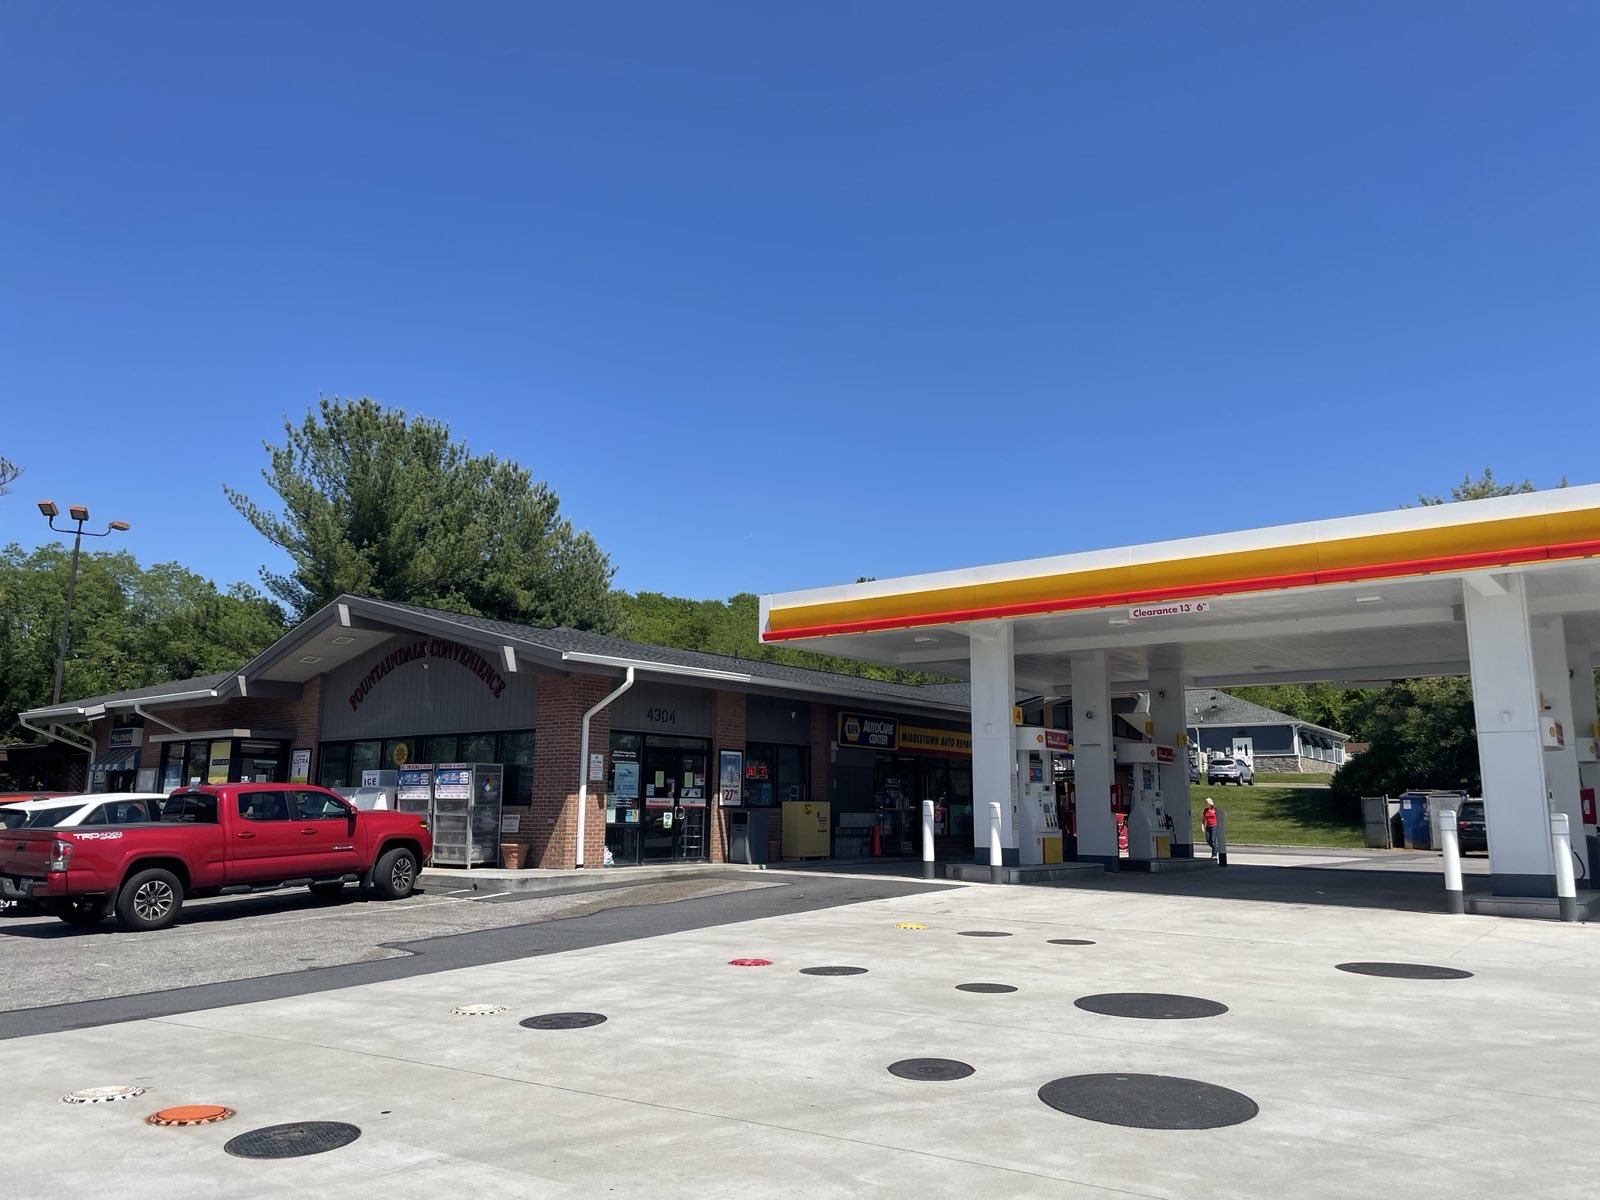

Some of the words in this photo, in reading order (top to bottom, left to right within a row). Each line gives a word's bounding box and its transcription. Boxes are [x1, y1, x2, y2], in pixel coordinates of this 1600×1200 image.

[1133, 606, 1178, 617] Clearance
[1180, 603, 1192, 612] 13'
[1196, 602, 1207, 611] 6"
[348, 641, 427, 712] FOUNTAINDALE
[428, 639, 507, 699] CONVENIENCE
[647, 707, 675, 725] 4304
[868, 734, 889, 746] CENTER
[902, 732, 939, 746] MIDDLETOWN
[941, 736, 955, 748] AUTO
[956, 738, 972, 749] REPAI
[364, 777, 376, 786] ICE
[73, 832, 100, 840] TRD
